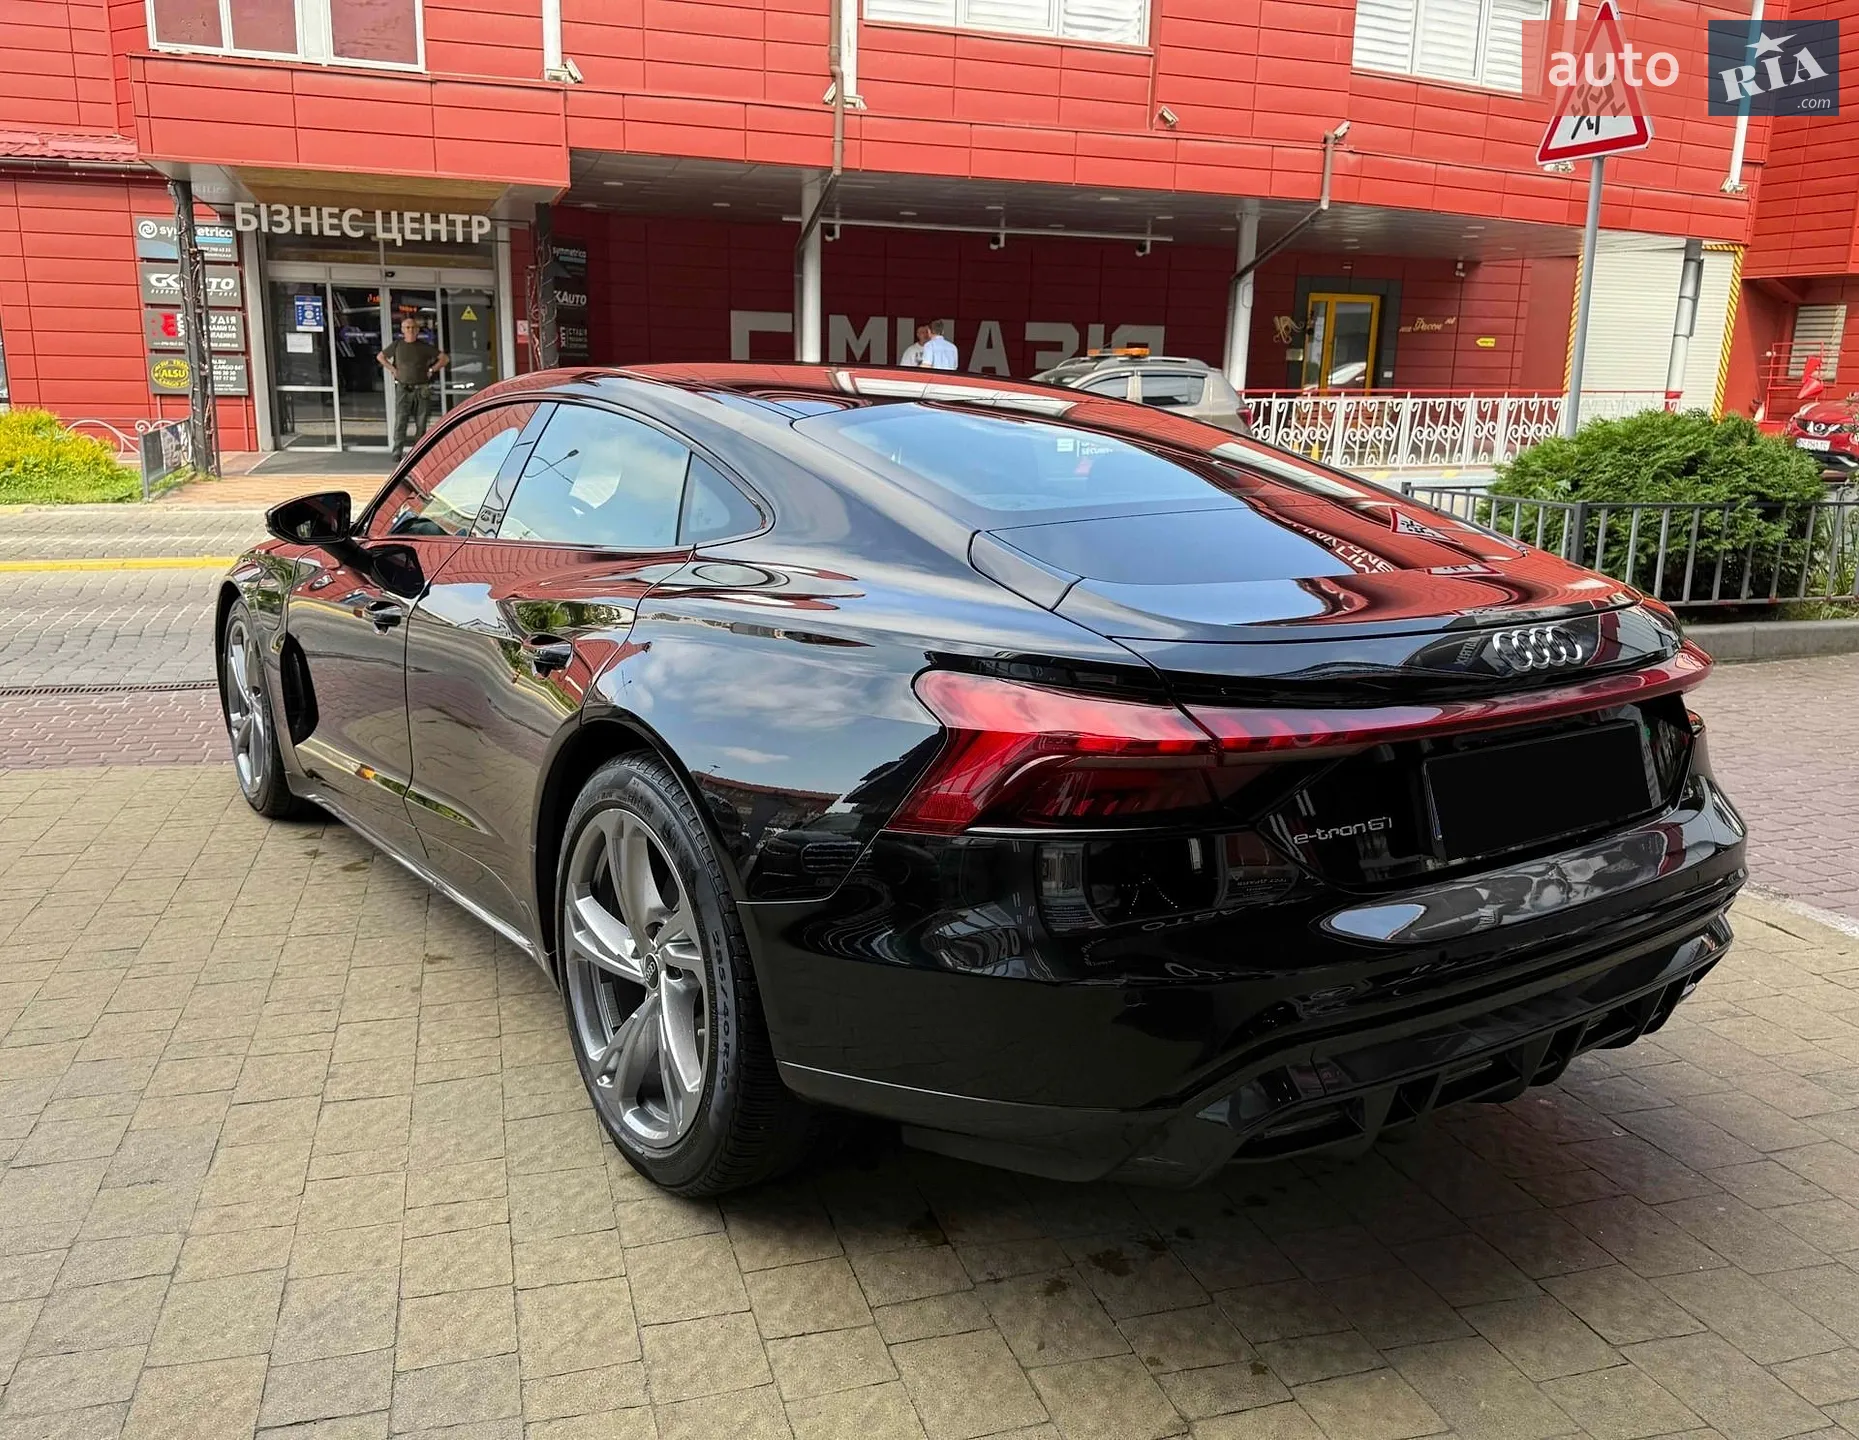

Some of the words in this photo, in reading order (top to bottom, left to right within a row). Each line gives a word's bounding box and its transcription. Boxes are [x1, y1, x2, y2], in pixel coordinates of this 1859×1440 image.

[234, 202, 365, 238] БІЗНЕС
[375, 209, 491, 246] ЦЕНТР
[161, 369, 185, 378] ALSU
[1293, 823, 1367, 845] e-tron
